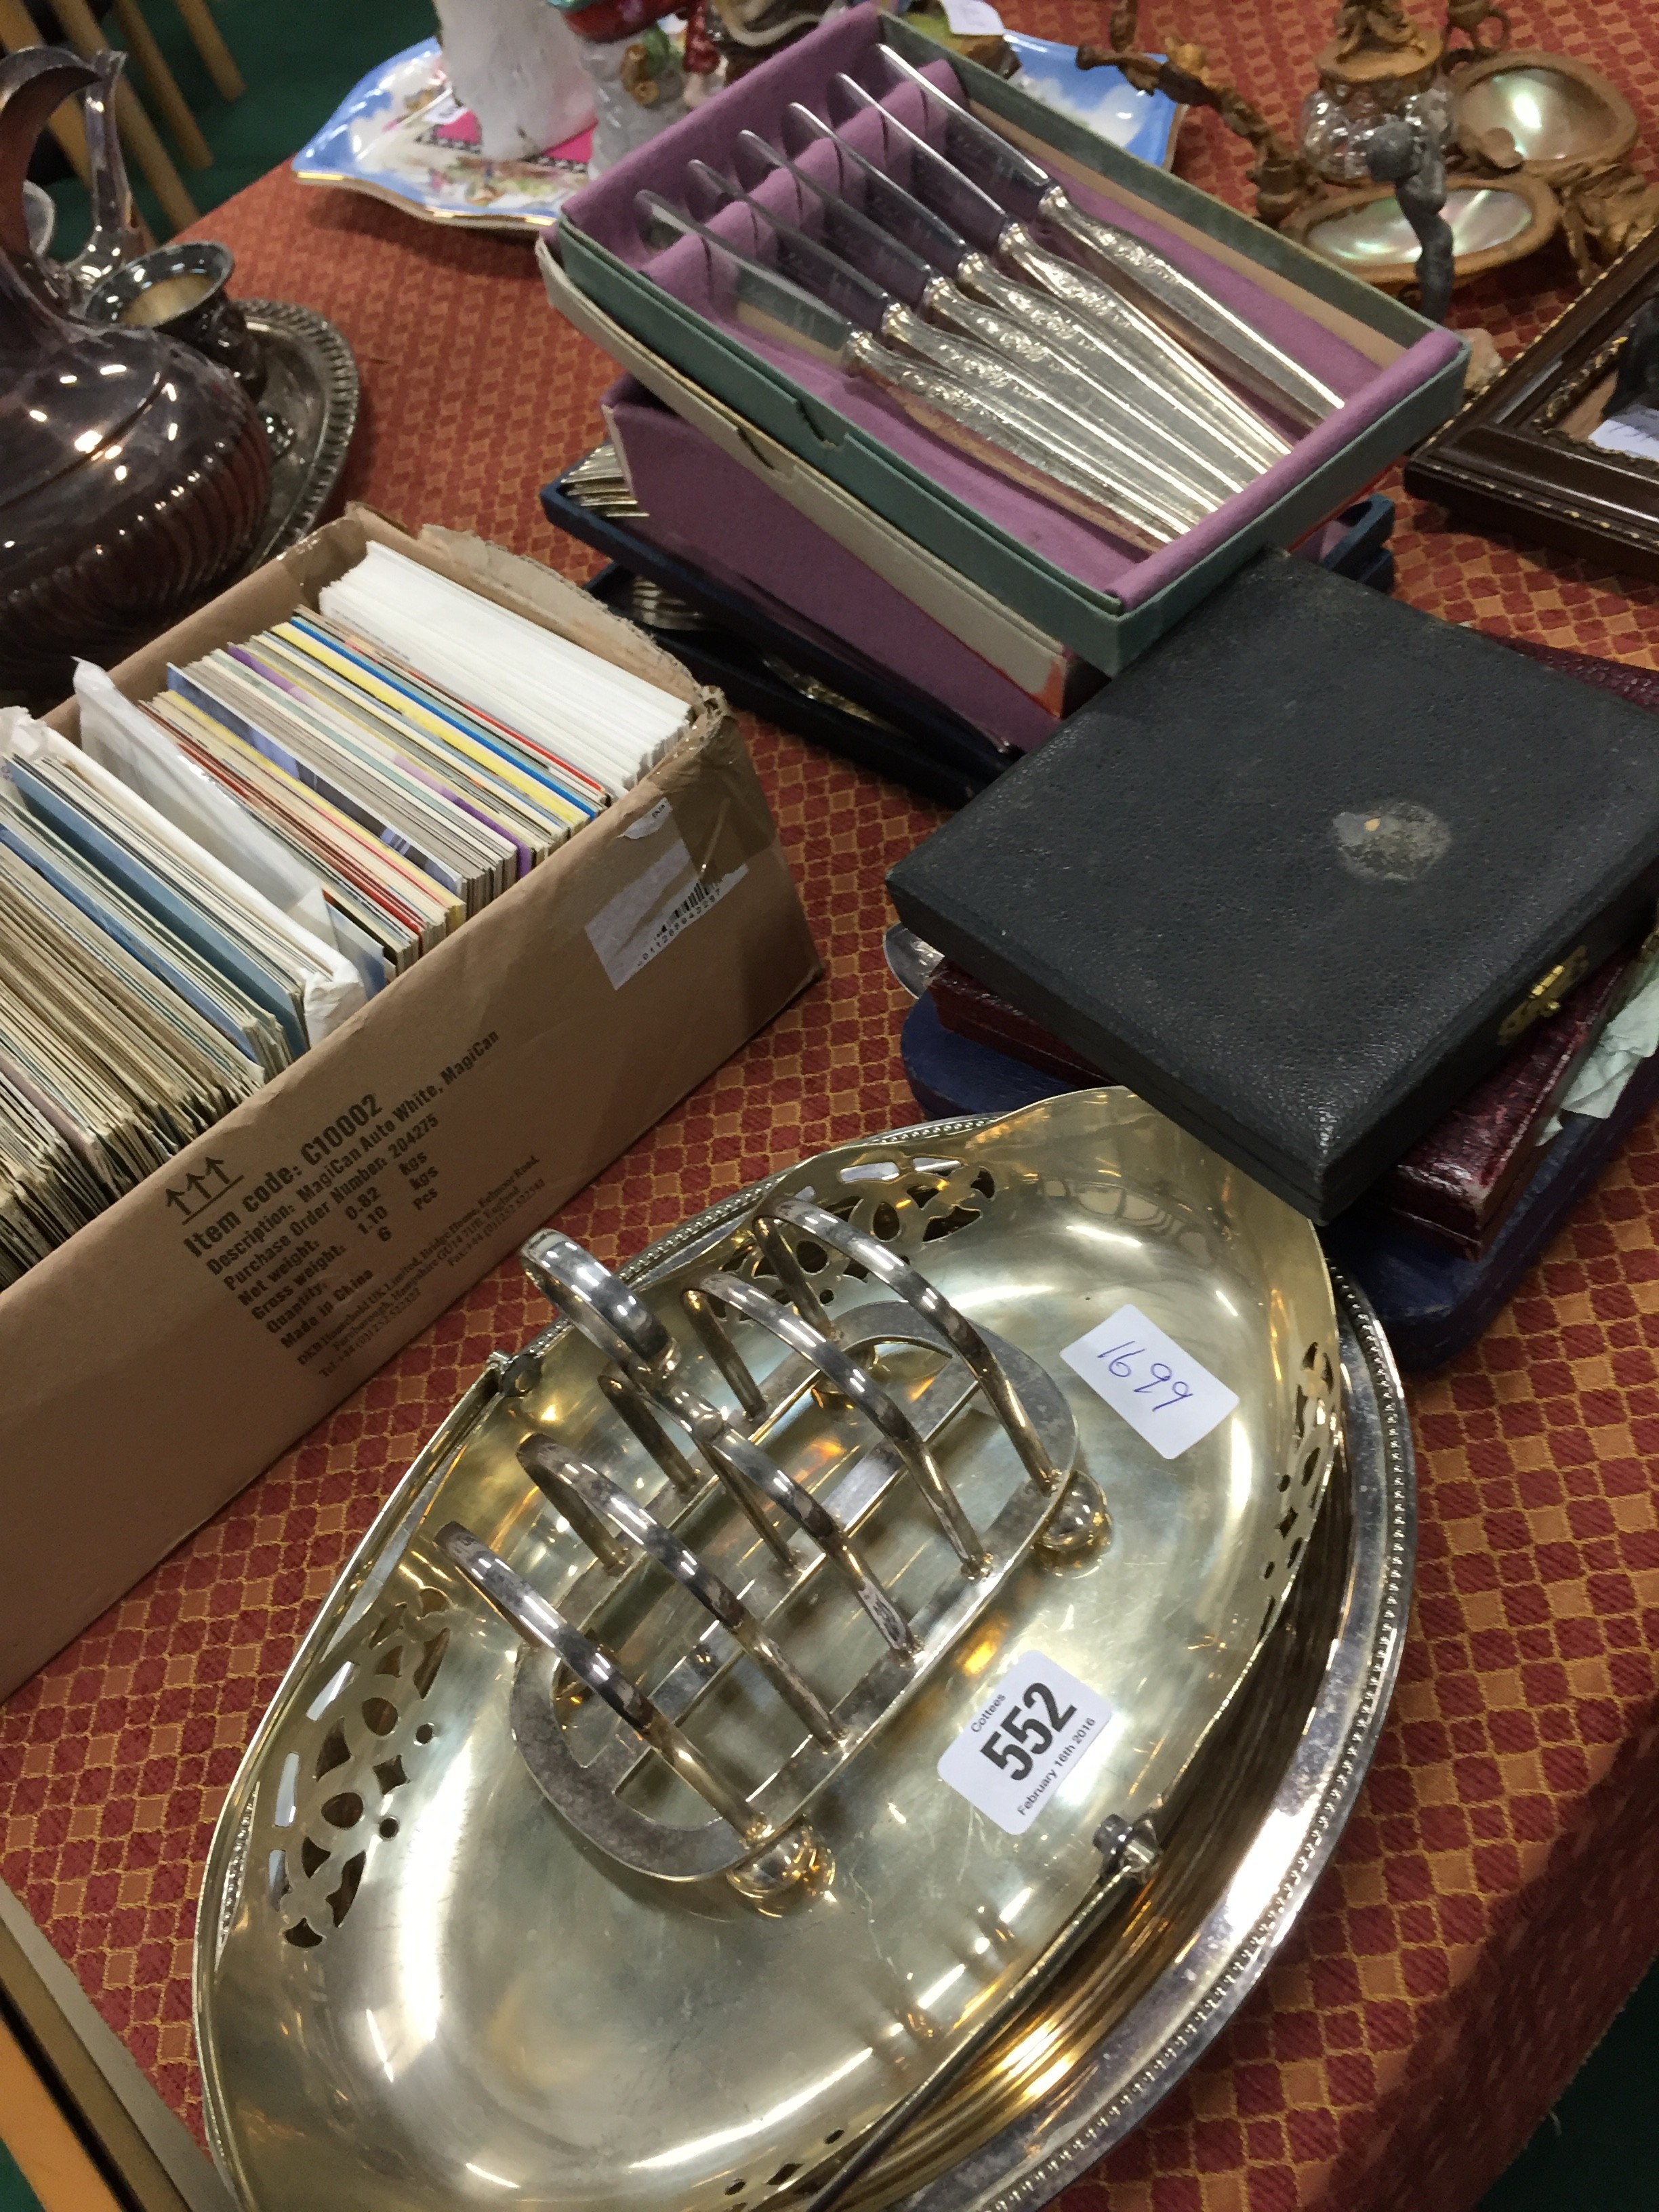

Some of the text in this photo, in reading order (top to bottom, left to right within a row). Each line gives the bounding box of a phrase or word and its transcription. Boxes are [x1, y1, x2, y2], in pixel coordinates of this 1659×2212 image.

[183, 1094, 382, 1258] Item code: C10002
[206, 1031, 499, 1275] Description: MagiCan Auto White, MagiCan
[223, 1235, 291, 1291] Purchase
[289, 1202, 331, 1236] Order
[388, 1113, 438, 1159] 204275
[237, 1279, 268, 1306] Net
[344, 1187, 381, 1221] 0.82
[398, 1151, 428, 1176] kgs
[251, 1286, 293, 1320] Gross
[357, 1206, 388, 1235] 1.10
[409, 1166, 439, 1191] kgs
[377, 1226, 392, 1242] 6
[411, 1188, 438, 1211] Pcs
[280, 1269, 373, 1349] Made in China
[367, 1288, 387, 1304] UK
[1097, 1340, 1193, 1412] 1699
[970, 1694, 1006, 1732] Cottees
[980, 1683, 1078, 1780] 552
[1017, 1718, 1096, 1816] February 16th 2016
